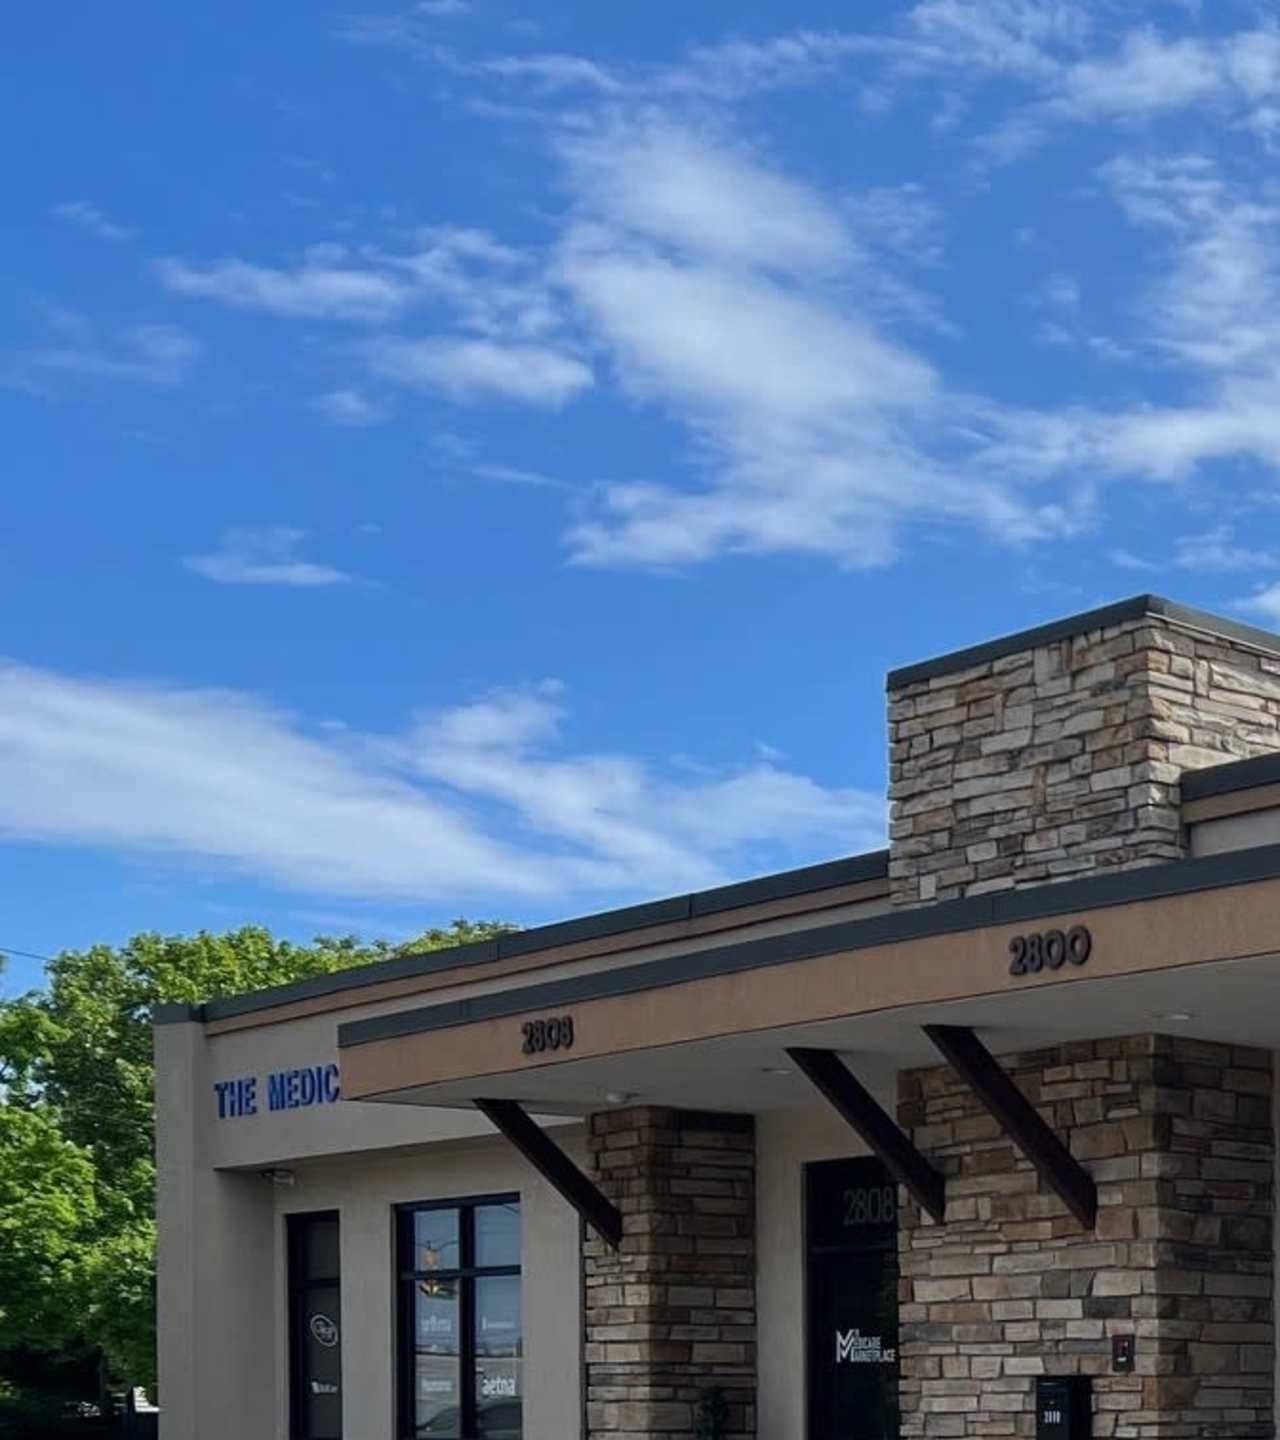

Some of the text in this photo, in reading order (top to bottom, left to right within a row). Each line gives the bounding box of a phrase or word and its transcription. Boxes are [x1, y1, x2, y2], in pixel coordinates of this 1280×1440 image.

[1009, 925, 1091, 976] 2800
[521, 1014, 574, 1055] 2808
[214, 1064, 340, 1119] THE MEDIC
[482, 1376, 516, 1396] aetna
